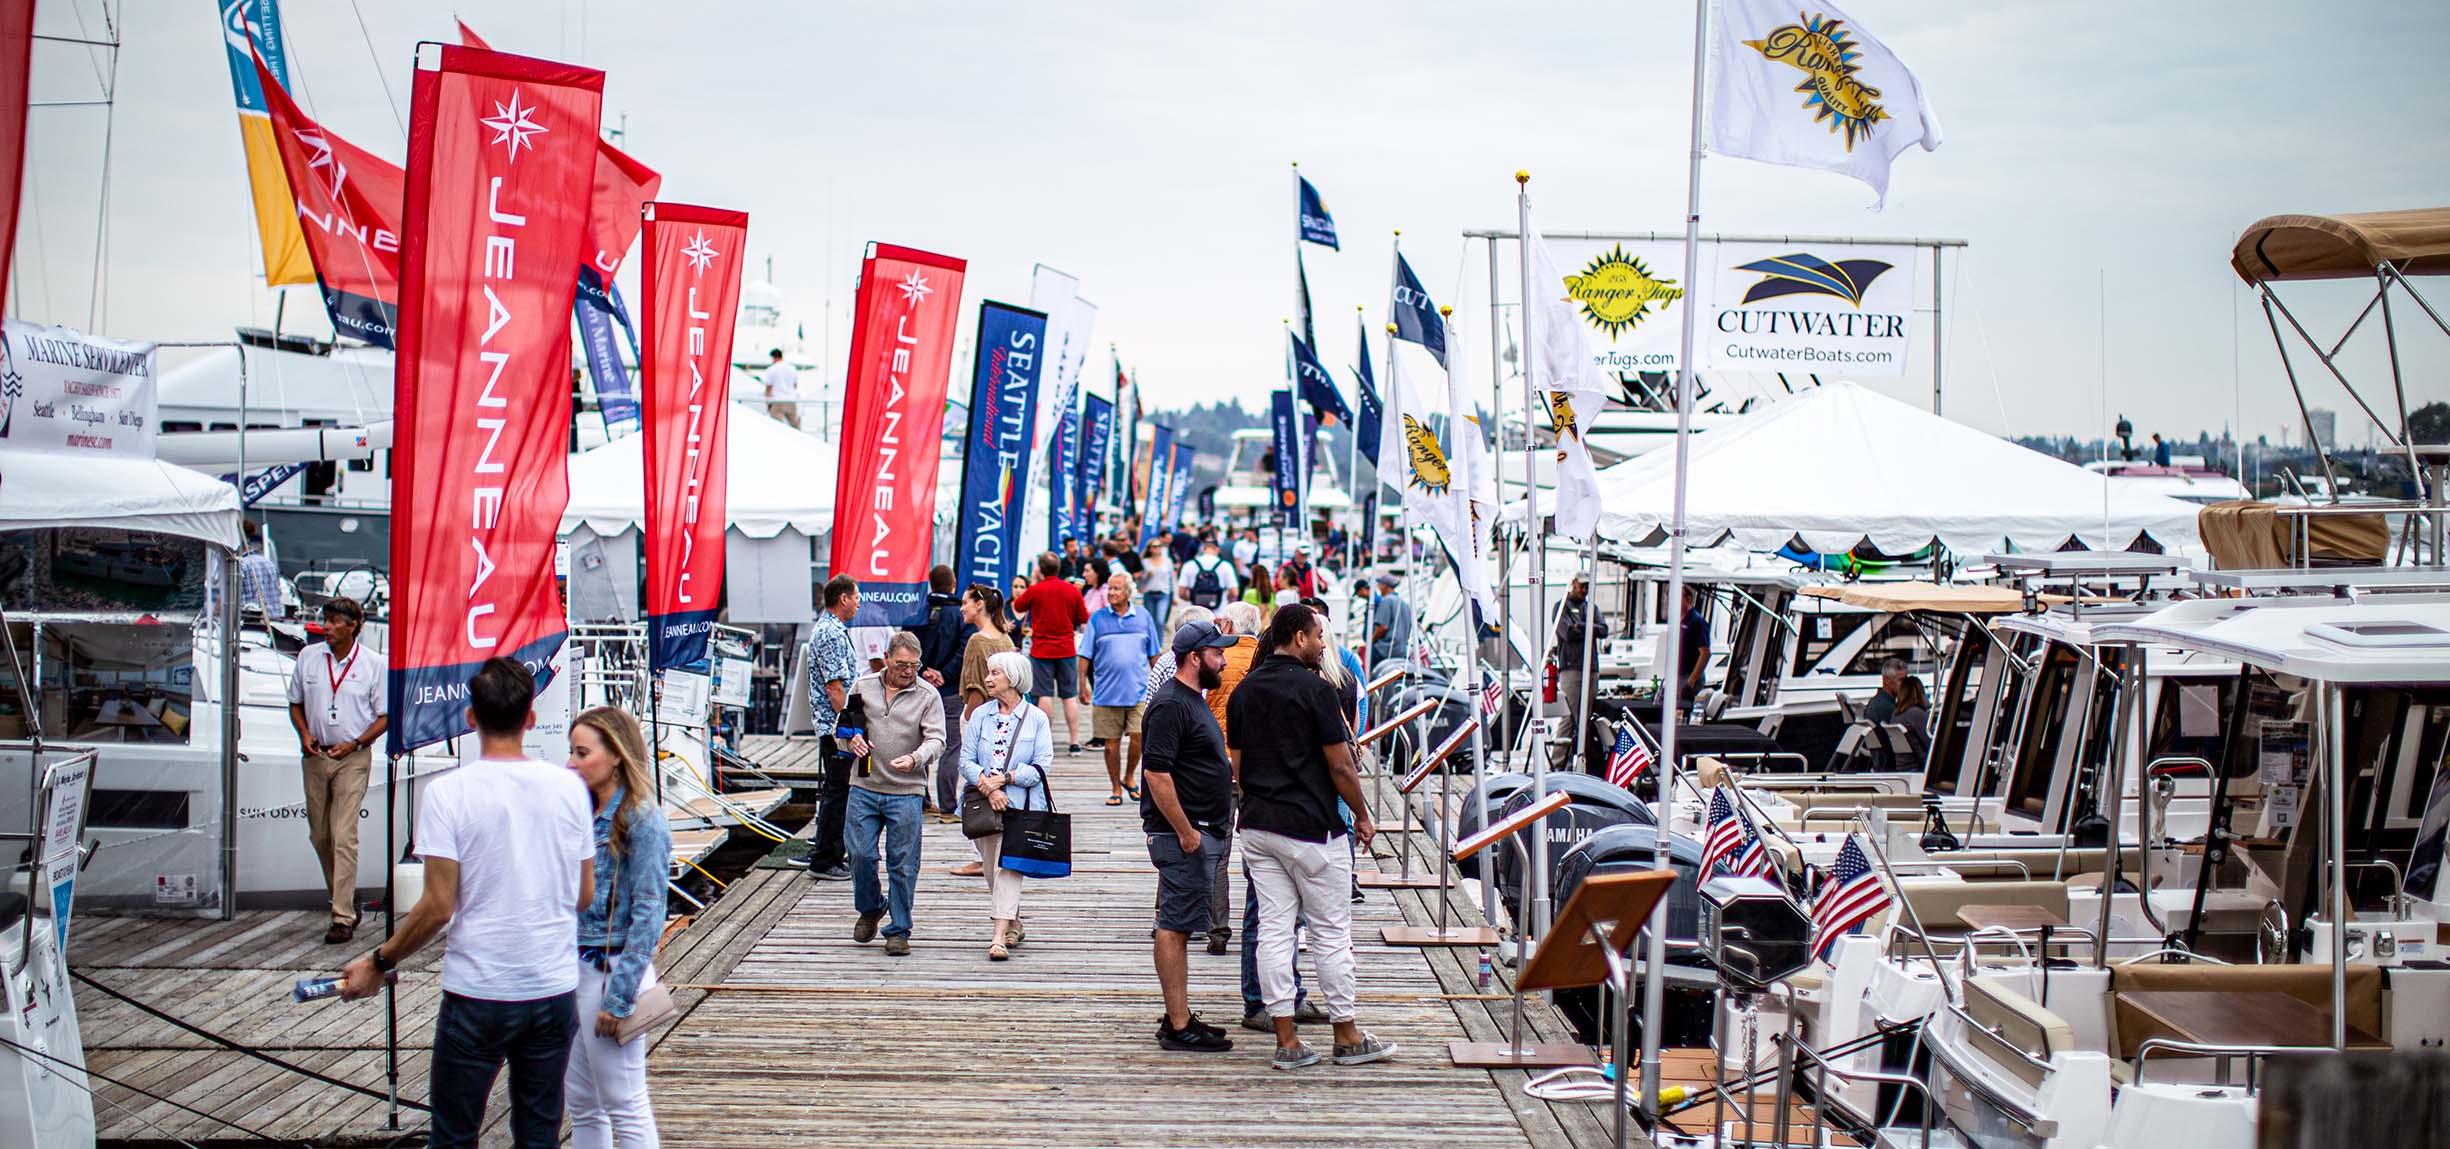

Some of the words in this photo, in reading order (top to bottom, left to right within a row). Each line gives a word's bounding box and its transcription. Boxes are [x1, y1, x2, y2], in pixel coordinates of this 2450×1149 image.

[1817, 76, 1849, 112] QUALITY
[1563, 275, 1635, 310] Ranger
[1637, 278, 1685, 311] Tugs
[1717, 309, 1905, 338] CUTWATER
[24, 335, 82, 368] MARINE
[1593, 351, 1675, 370] erTugs.com
[1726, 343, 1893, 363] CutwaterBoats.com
[467, 176, 526, 649] JEANNEAU
[983, 344, 1008, 450] International
[998, 329, 1036, 470] SEATTLE
[33, 400, 56, 419] Seattle
[71, 404, 105, 428] Bellingham
[678, 286, 710, 604] JEANNEAU
[870, 314, 919, 577] JEANNEAU
[857, 591, 920, 604] NNEAU.COM
[664, 620, 712, 639] EANNEAU.CO
[270, 808, 308, 819] ODYS
[1547, 828, 1593, 843] AMAHA
